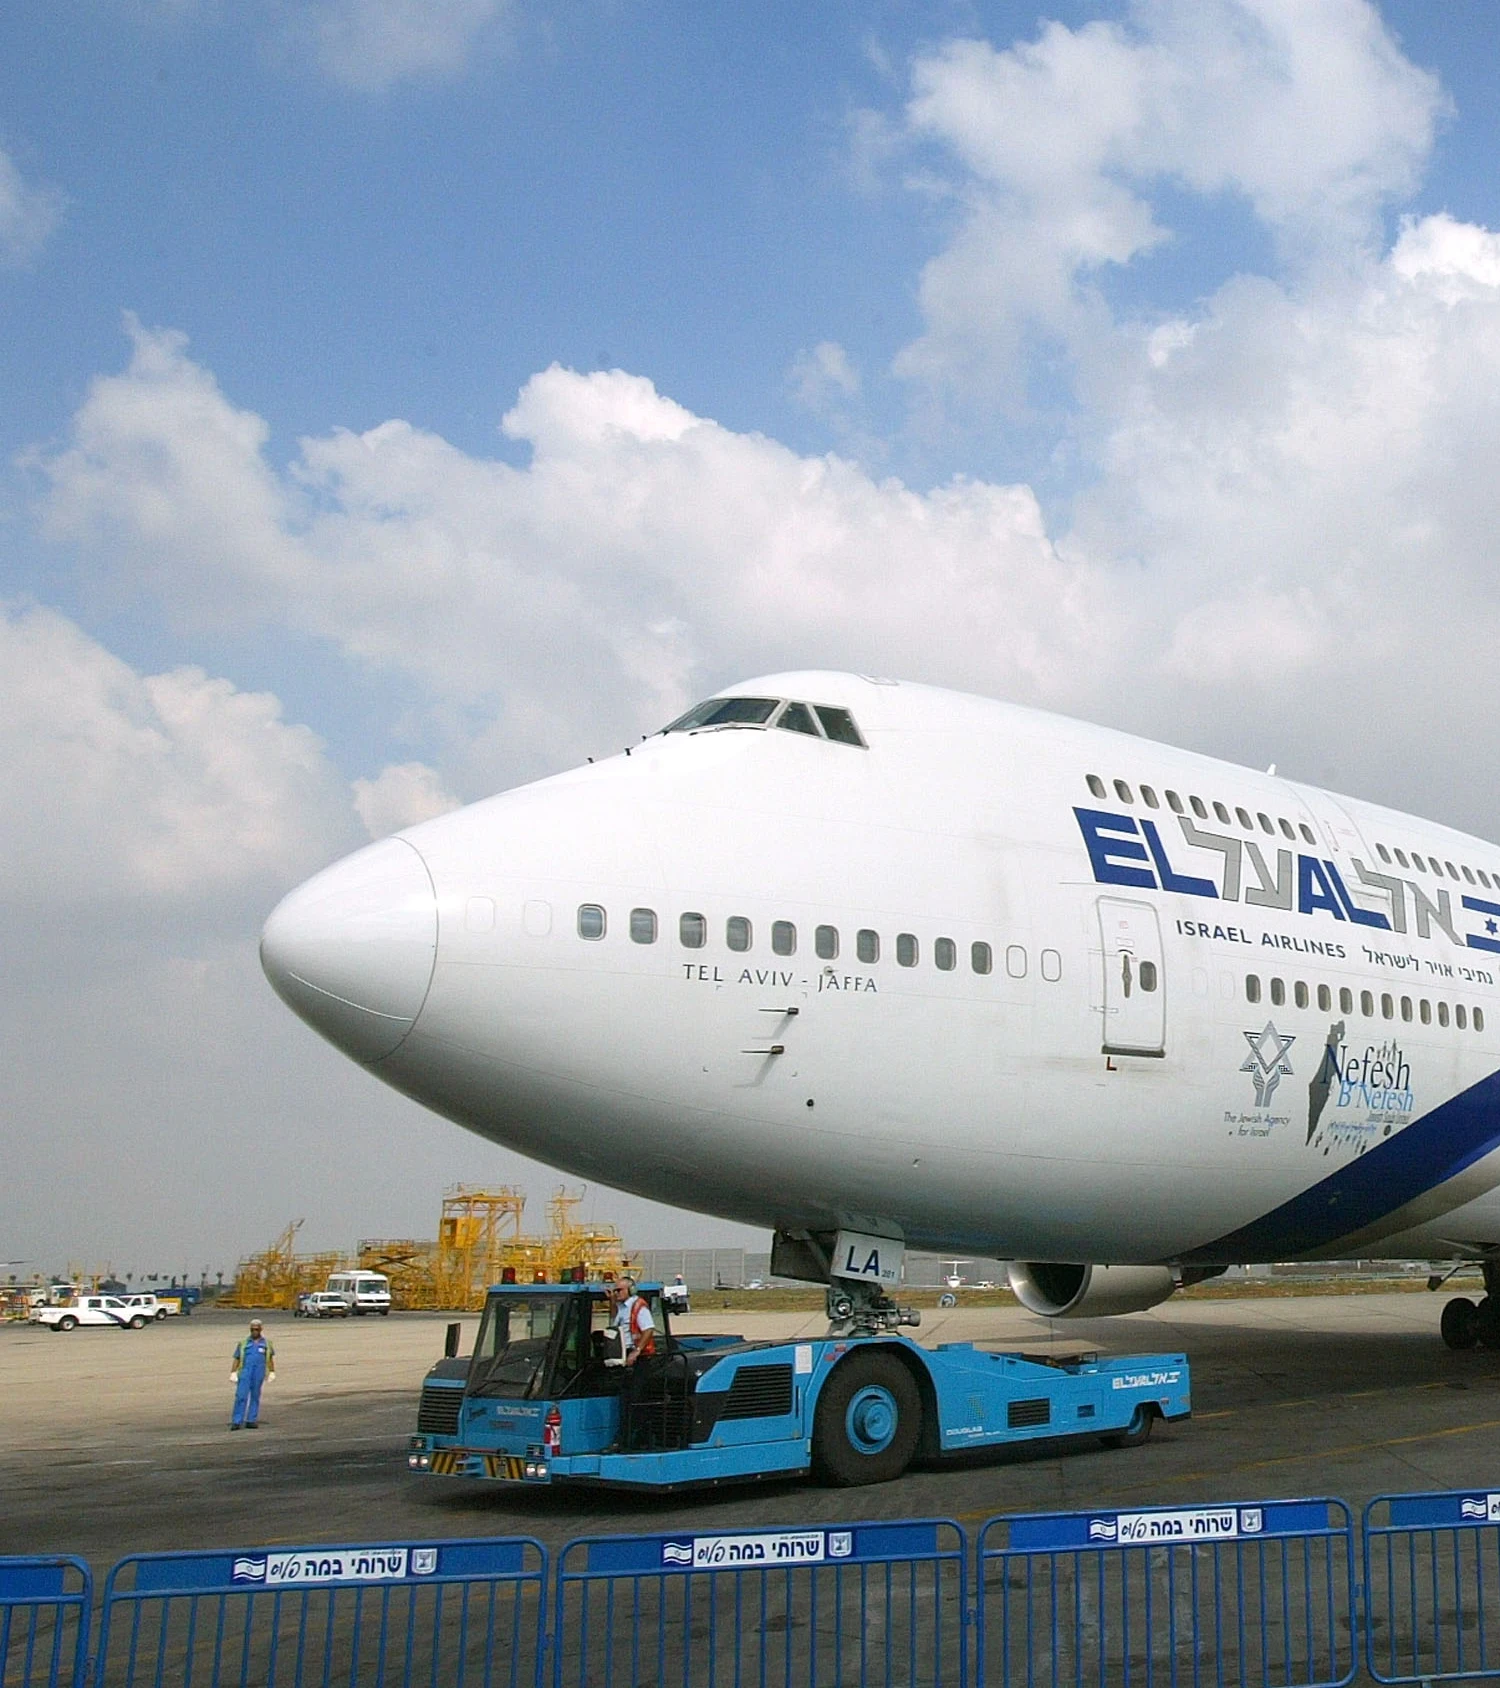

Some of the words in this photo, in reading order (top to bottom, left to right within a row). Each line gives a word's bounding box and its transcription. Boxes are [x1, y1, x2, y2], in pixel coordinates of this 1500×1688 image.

[1072, 806, 1219, 900] EL
[1298, 854, 1392, 931] AL
[1176, 920, 1252, 944] ISRAEL
[1261, 933, 1346, 958] AIRLINES
[1362, 945, 1419, 971] לישראל
[683, 964, 724, 982] TEL
[738, 969, 793, 986] AVIV
[818, 974, 878, 992] JAFFA
[1425, 961, 1453, 977] אויר
[1458, 967, 1493, 984] נתיבי
[1320, 1043, 1410, 1090] Nefesh
[846, 1245, 879, 1276] LA
[1150, 1519, 1182, 1537] במה
[1190, 1515, 1232, 1534] שרותי
[730, 1543, 764, 1560] במה
[773, 1540, 819, 1558] שרותי
[305, 1559, 342, 1576] במה
[352, 1555, 401, 1574] שרותי
